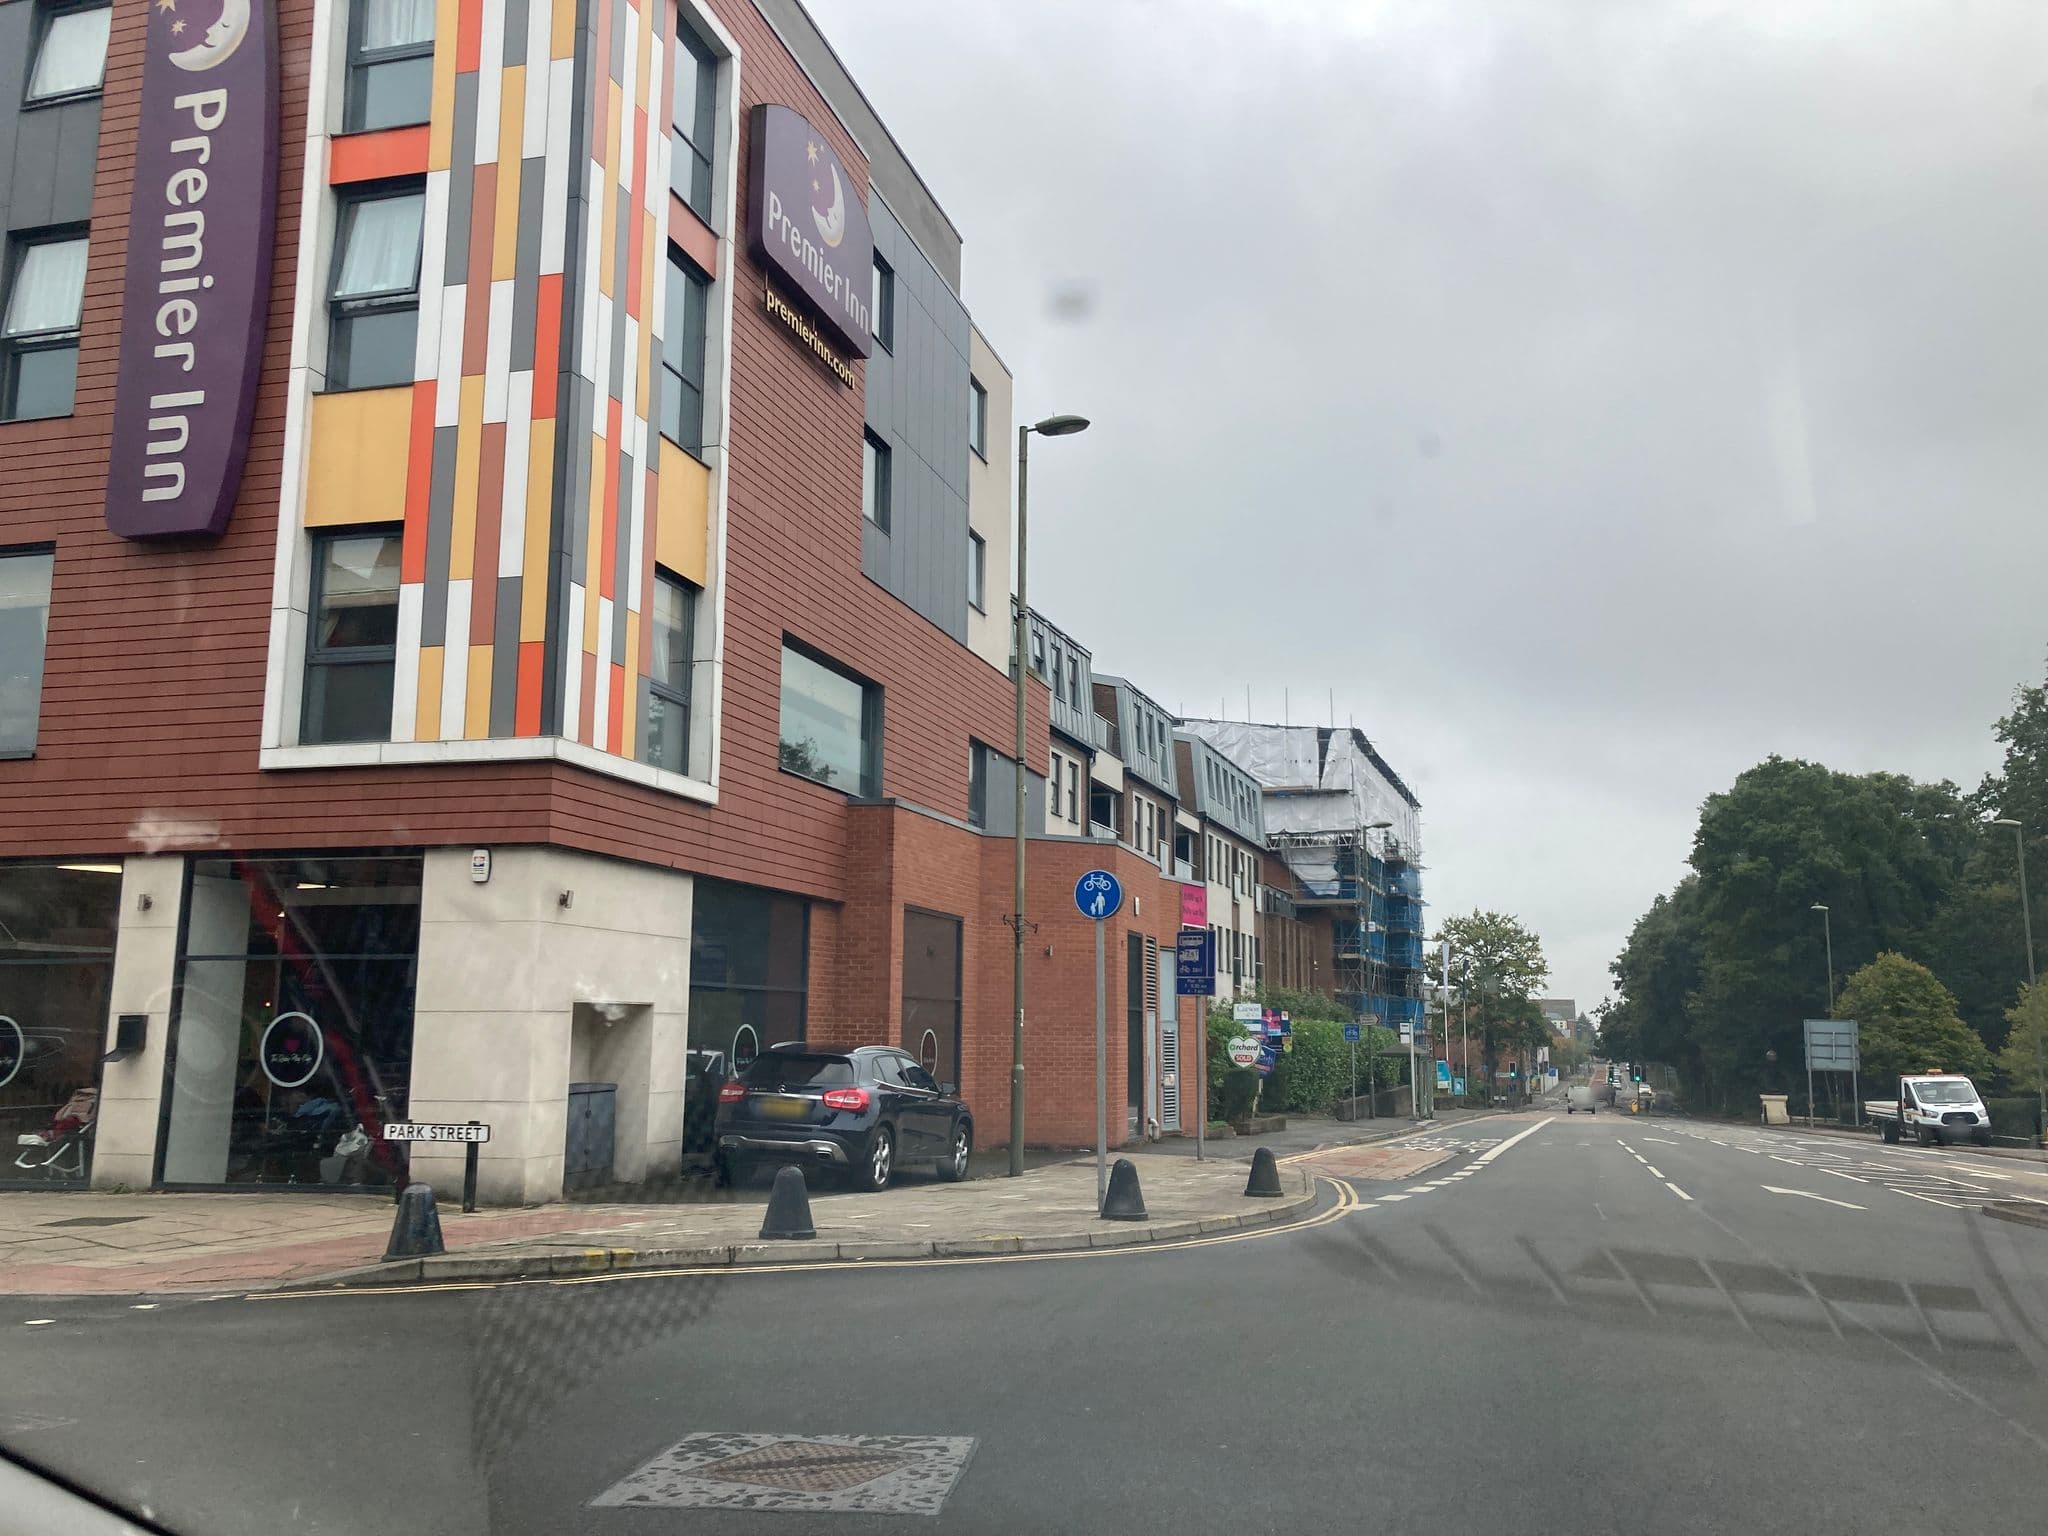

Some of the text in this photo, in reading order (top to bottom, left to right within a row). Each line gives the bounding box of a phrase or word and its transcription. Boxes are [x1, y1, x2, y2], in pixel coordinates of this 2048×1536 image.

[142, 88, 227, 502] Premier Inn
[769, 190, 869, 336] Premier Inn
[766, 287, 855, 390] premierinn.com
[389, 1125, 482, 1140] PARK STREET
